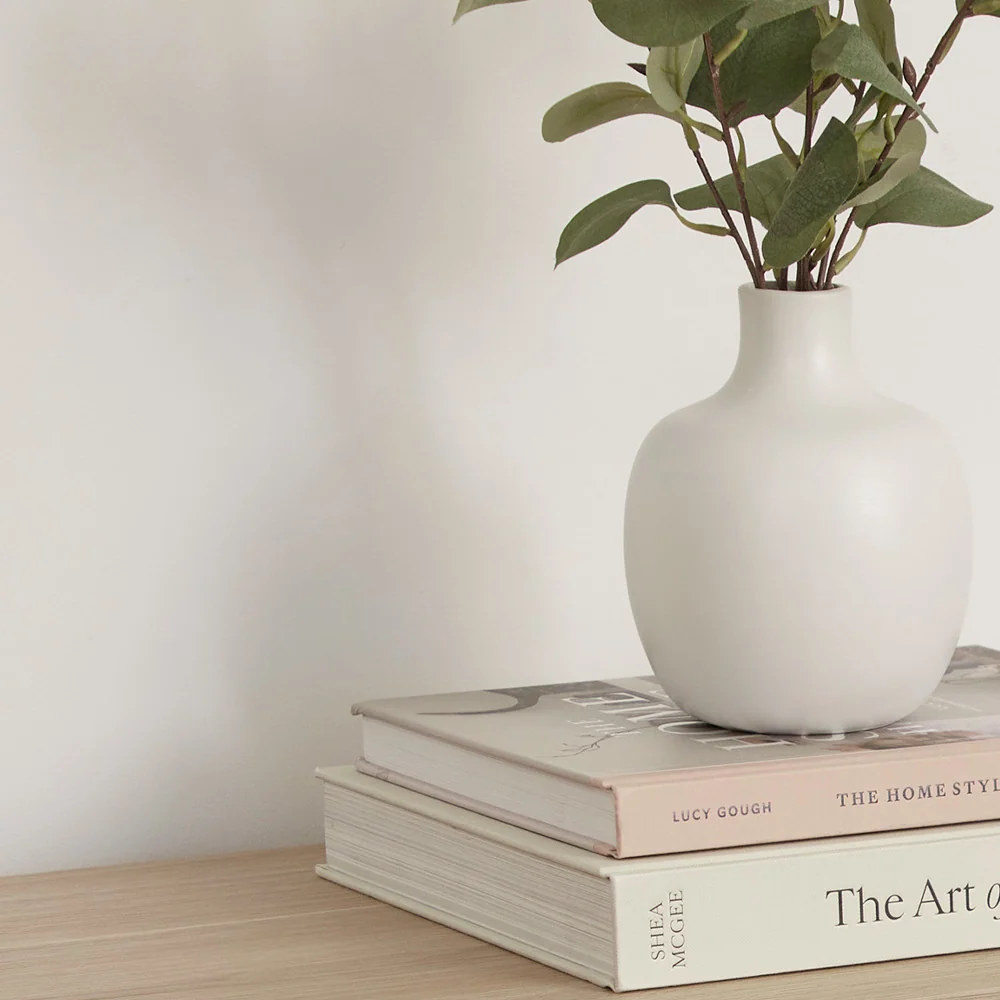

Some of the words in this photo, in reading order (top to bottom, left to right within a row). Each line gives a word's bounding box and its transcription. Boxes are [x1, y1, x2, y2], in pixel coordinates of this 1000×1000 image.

[672, 807, 711, 823] LUCY
[716, 801, 772, 819] GOUGH
[836, 789, 879, 808] THE
[885, 782, 947, 803] HOME
[826, 885, 905, 927] The
[912, 878, 977, 918] Art
[648, 901, 666, 961] SHEA
[668, 889, 687, 969] MCGEE
